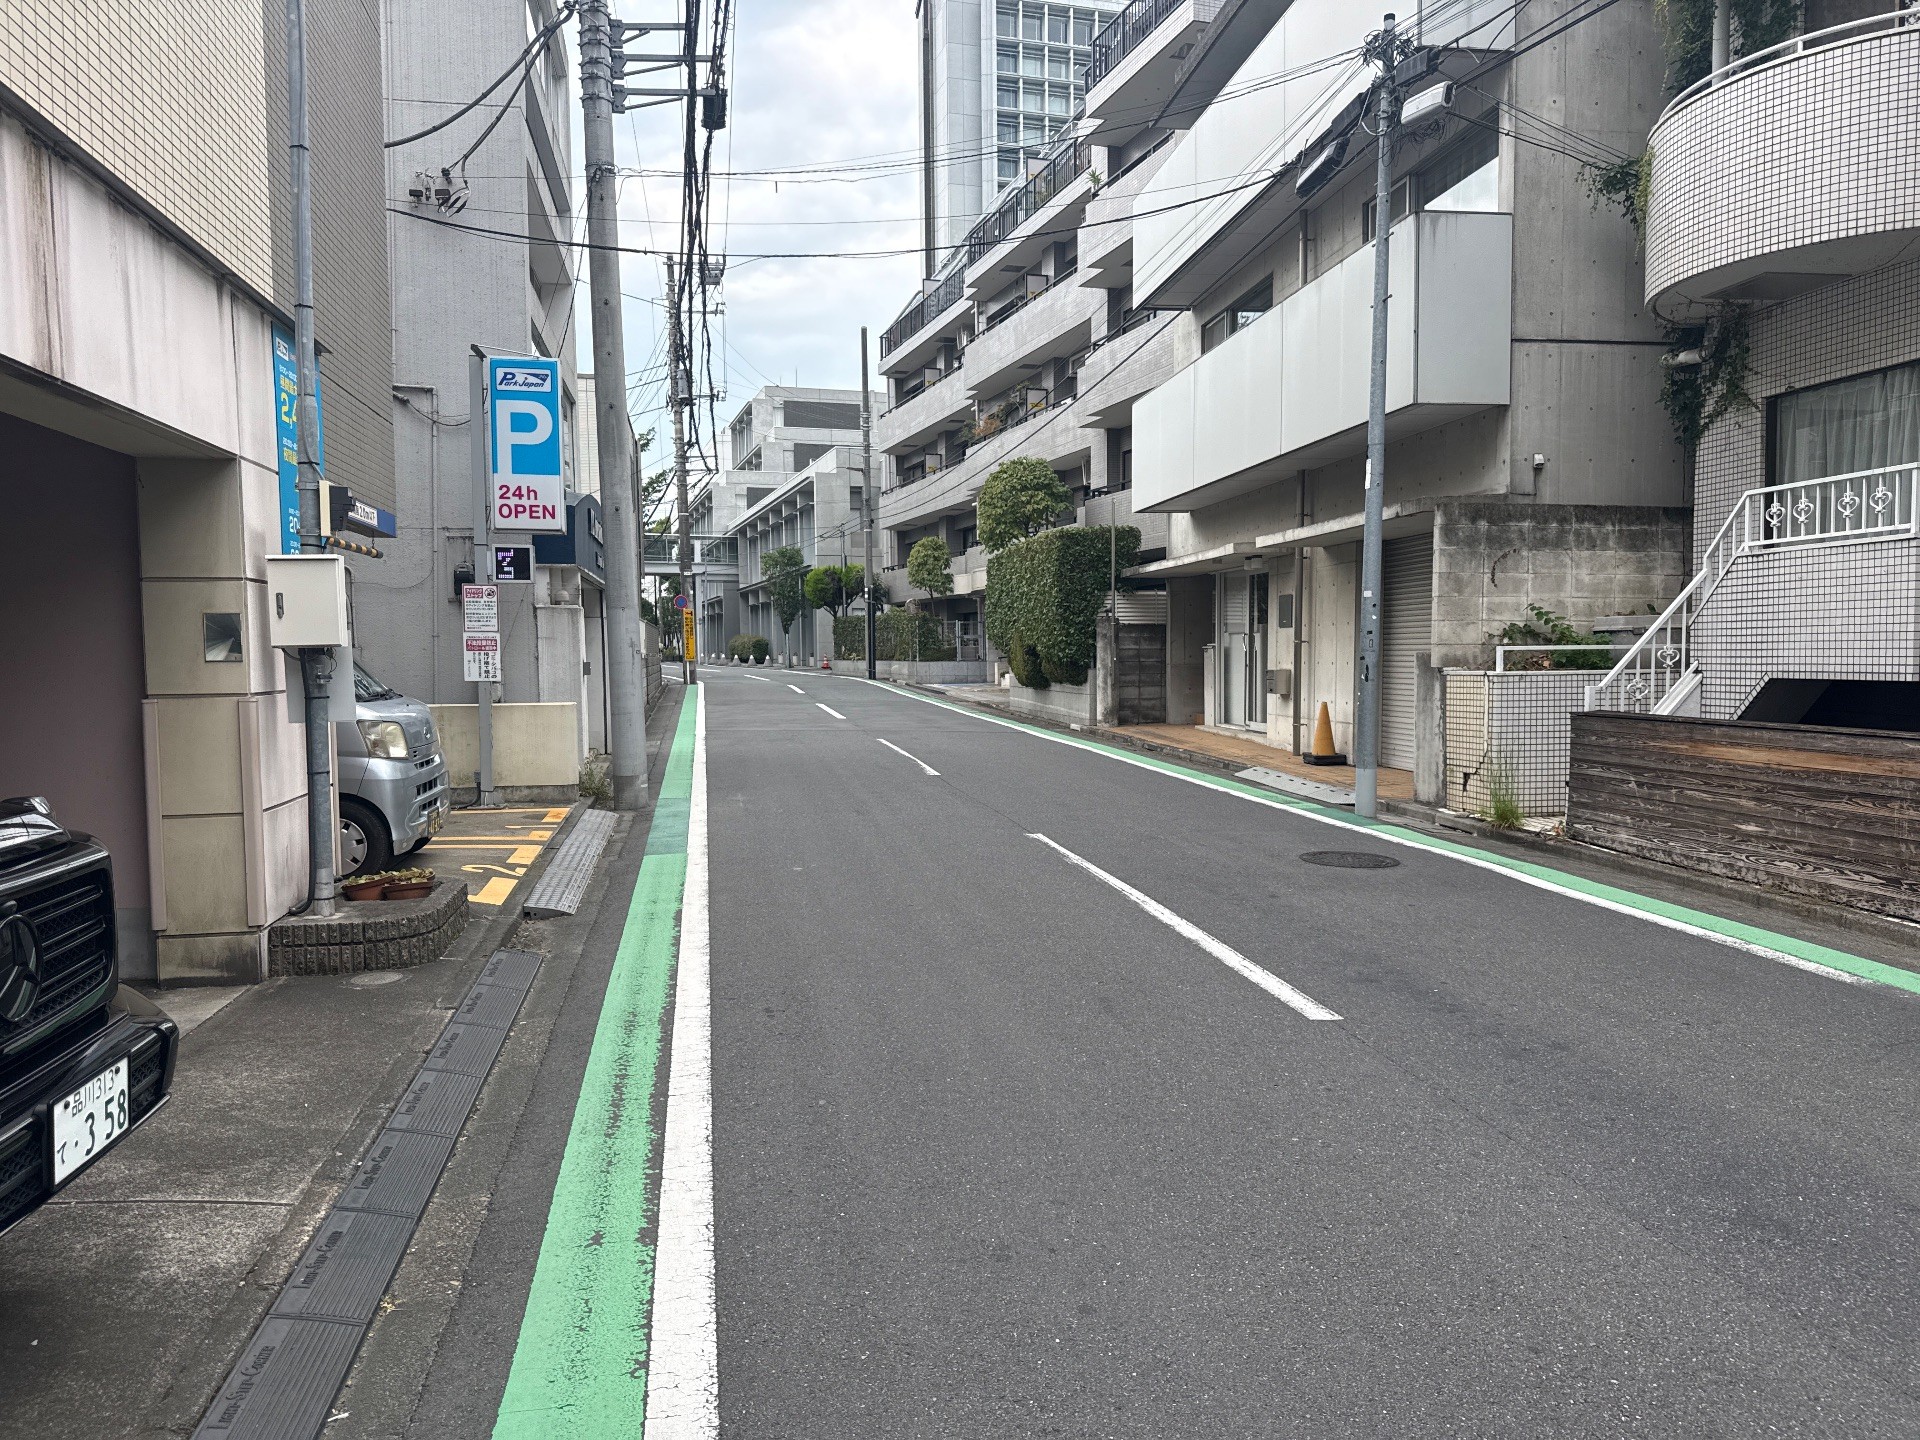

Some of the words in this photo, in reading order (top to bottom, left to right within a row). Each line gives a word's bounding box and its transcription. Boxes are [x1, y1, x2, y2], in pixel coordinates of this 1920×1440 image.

[496, 399, 553, 475] P
[498, 484, 538, 501] 24h
[498, 503, 556, 520] OPEN
